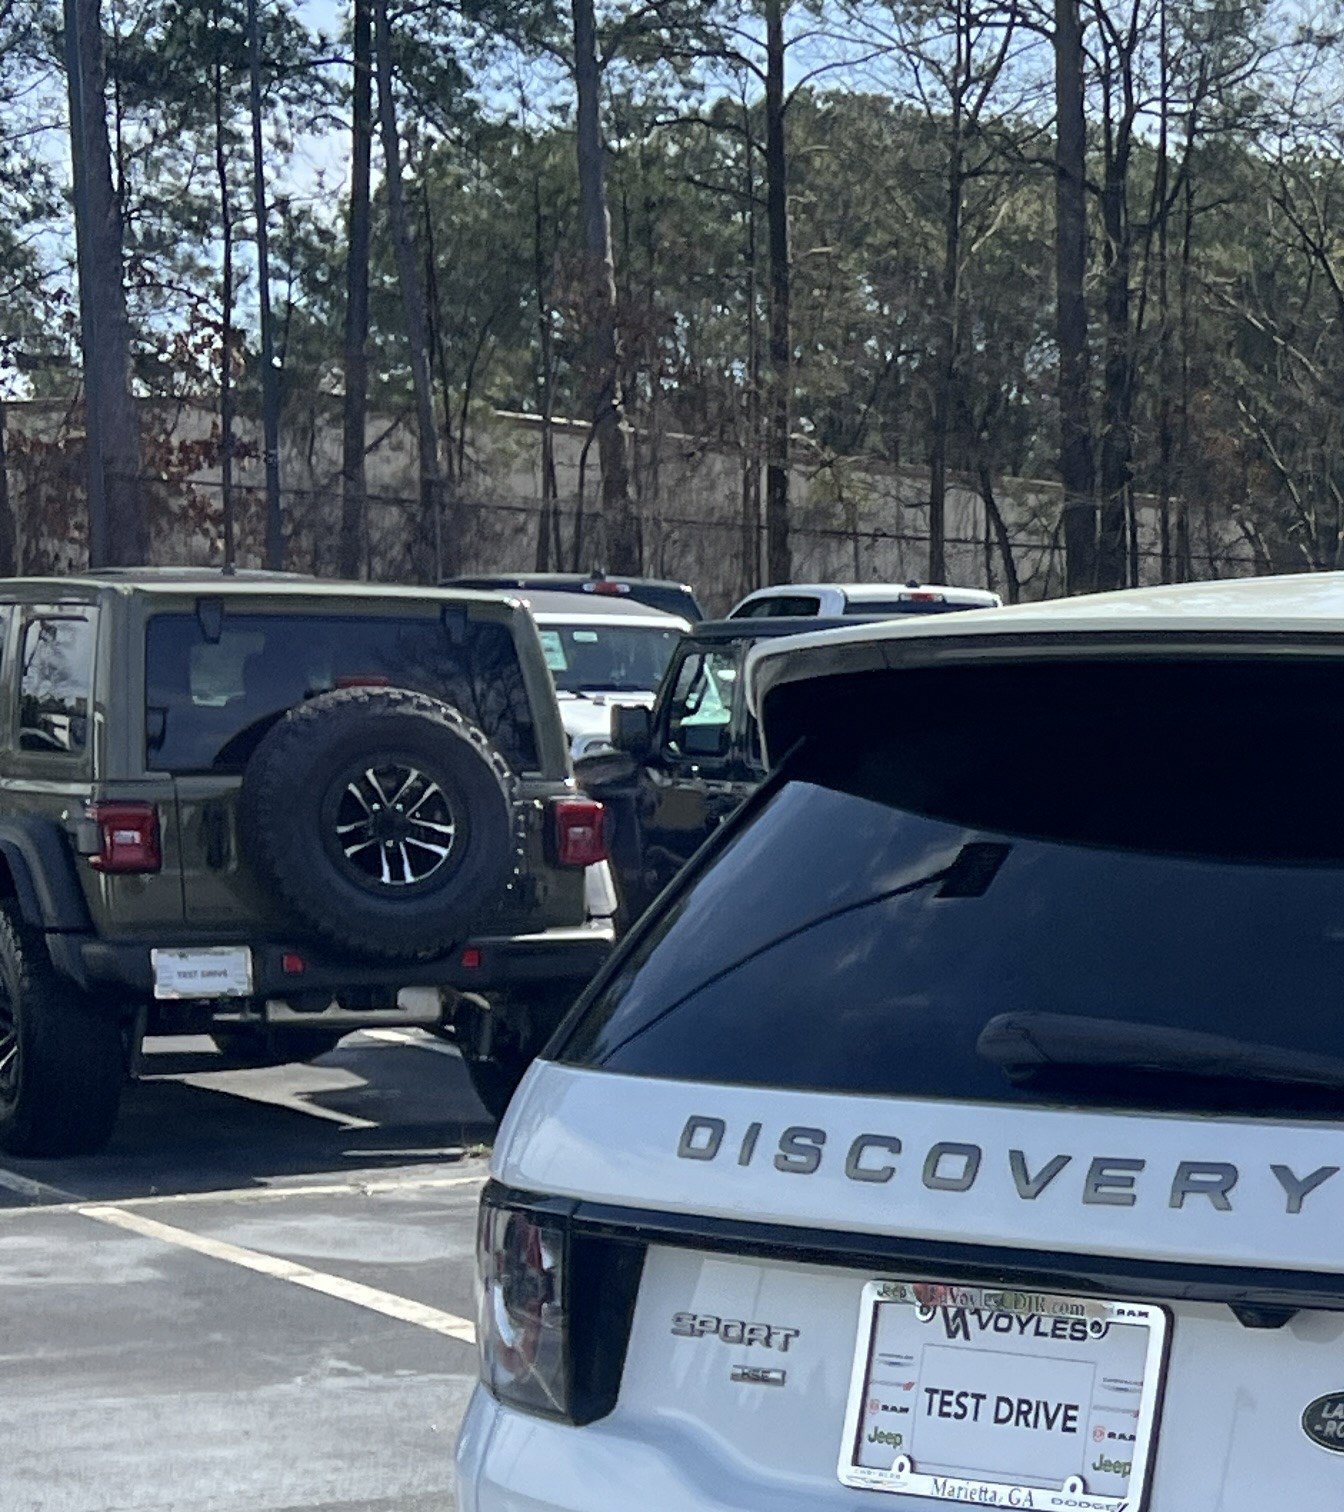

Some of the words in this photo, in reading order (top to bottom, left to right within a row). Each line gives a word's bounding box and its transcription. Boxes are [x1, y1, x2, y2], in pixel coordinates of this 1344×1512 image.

[676, 1113, 1341, 1214] DISCOVERY
[971, 1308, 1088, 1342] VOYLES
[1116, 1307, 1150, 1319] RAM
[670, 1311, 800, 1353] SPORT
[924, 1386, 987, 1423] TEST
[993, 1395, 1080, 1433] DRIVE
[867, 1426, 903, 1450] Jeep
[1091, 1453, 1132, 1479] Jeep
[931, 1477, 1004, 1504] Marietta,
[1008, 1487, 1035, 1508] GA
